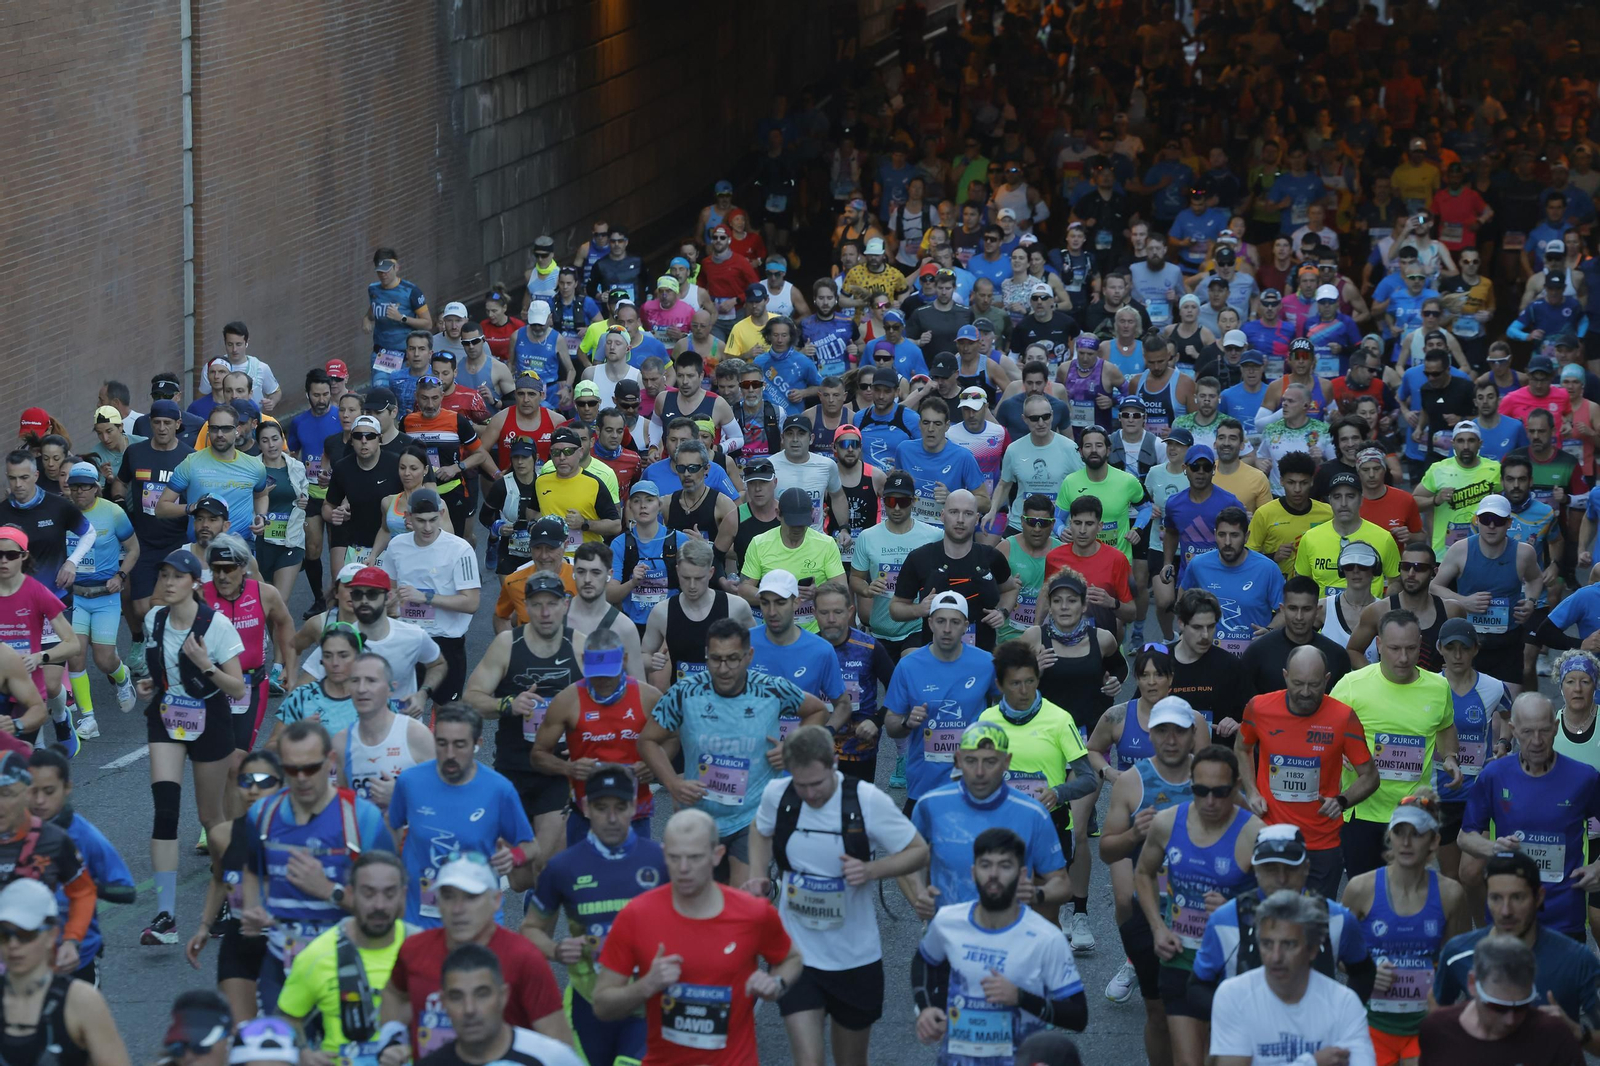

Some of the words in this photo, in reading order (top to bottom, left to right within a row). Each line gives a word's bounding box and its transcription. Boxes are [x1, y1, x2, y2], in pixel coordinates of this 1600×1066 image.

[405, 609, 427, 618] PERRY
[1472, 616, 1502, 626] RAMON
[845, 660, 863, 668] HOKA
[174, 698, 202, 708] ZURICH
[164, 717, 199, 731] MARION
[939, 720, 967, 728] ZURICH
[582, 731, 617, 744] Puerto
[1392, 737, 1421, 746] ZURICH
[1391, 750, 1408, 758] 8171
[714, 757, 745, 768] ZURICH
[1286, 758, 1316, 768] ZURICH
[1374, 759, 1424, 772] CONSTANTIN
[1285, 771, 1305, 780] 11832
[708, 779, 738, 794] JAUME
[1282, 780, 1308, 792] TUTU
[1528, 834, 1560, 843] ZURICH
[1526, 848, 1547, 857] 11572
[806, 881, 840, 891] ZURICH
[963, 950, 1006, 967] JEREZ
[1393, 958, 1427, 968] ZURICH
[685, 988, 725, 1000] ZURICH
[1383, 986, 1421, 999] PAULA
[674, 1015, 714, 1034] DAVID
